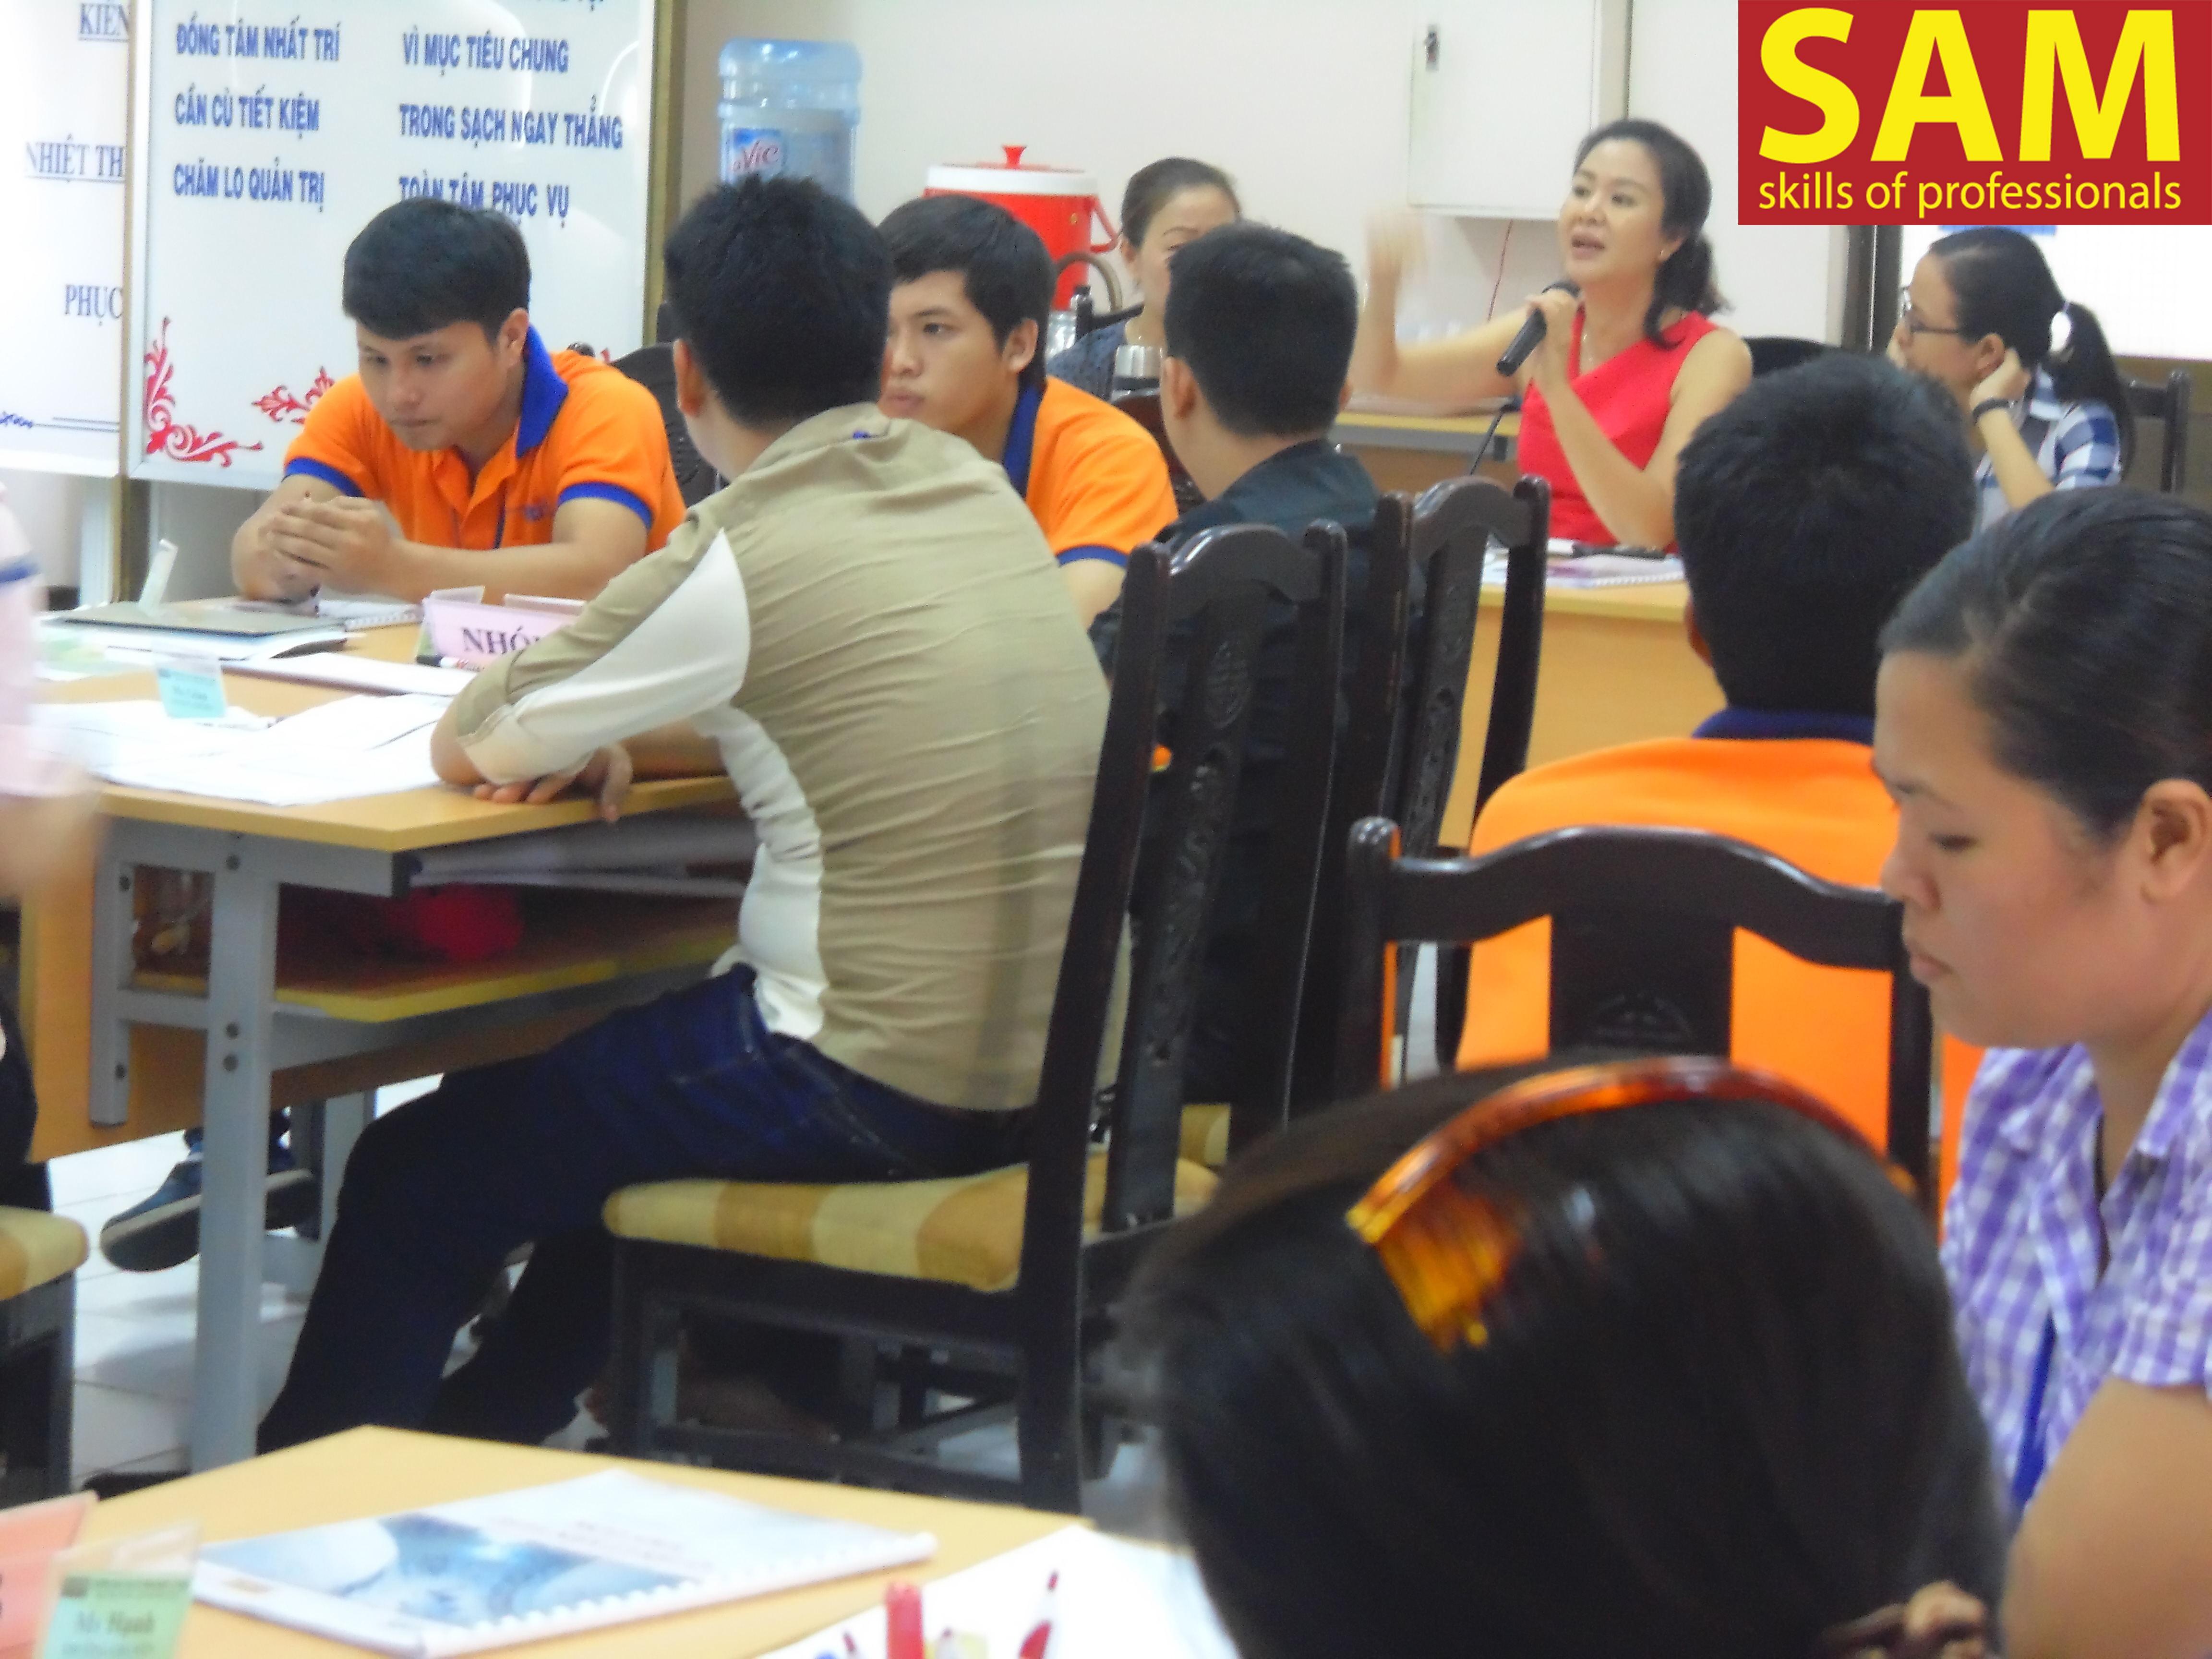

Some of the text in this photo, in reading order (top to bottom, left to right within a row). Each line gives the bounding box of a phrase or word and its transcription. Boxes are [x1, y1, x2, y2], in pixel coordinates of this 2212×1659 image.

[226, 18, 259, 58] TÂM
[264, 15, 308, 60] NHẤT
[314, 21, 341, 61] TRÍ
[403, 25, 569, 76] VÌ MỤC TIÊU CHUNG
[212, 87, 234, 127] CÙ
[239, 84, 274, 128] TIẾT
[279, 92, 320, 139] KIỆM
[399, 104, 455, 139] TRONG
[460, 106, 505, 148] SẠCH
[511, 111, 559, 144] NGAY
[225, 167, 244, 199] LO
[249, 156, 294, 202] QUẢN
[299, 170, 325, 212] TRỊ
[399, 169, 569, 228] TOÀN TÂM PHỤC VỤ
[462, 626, 540, 655] NHÓ
